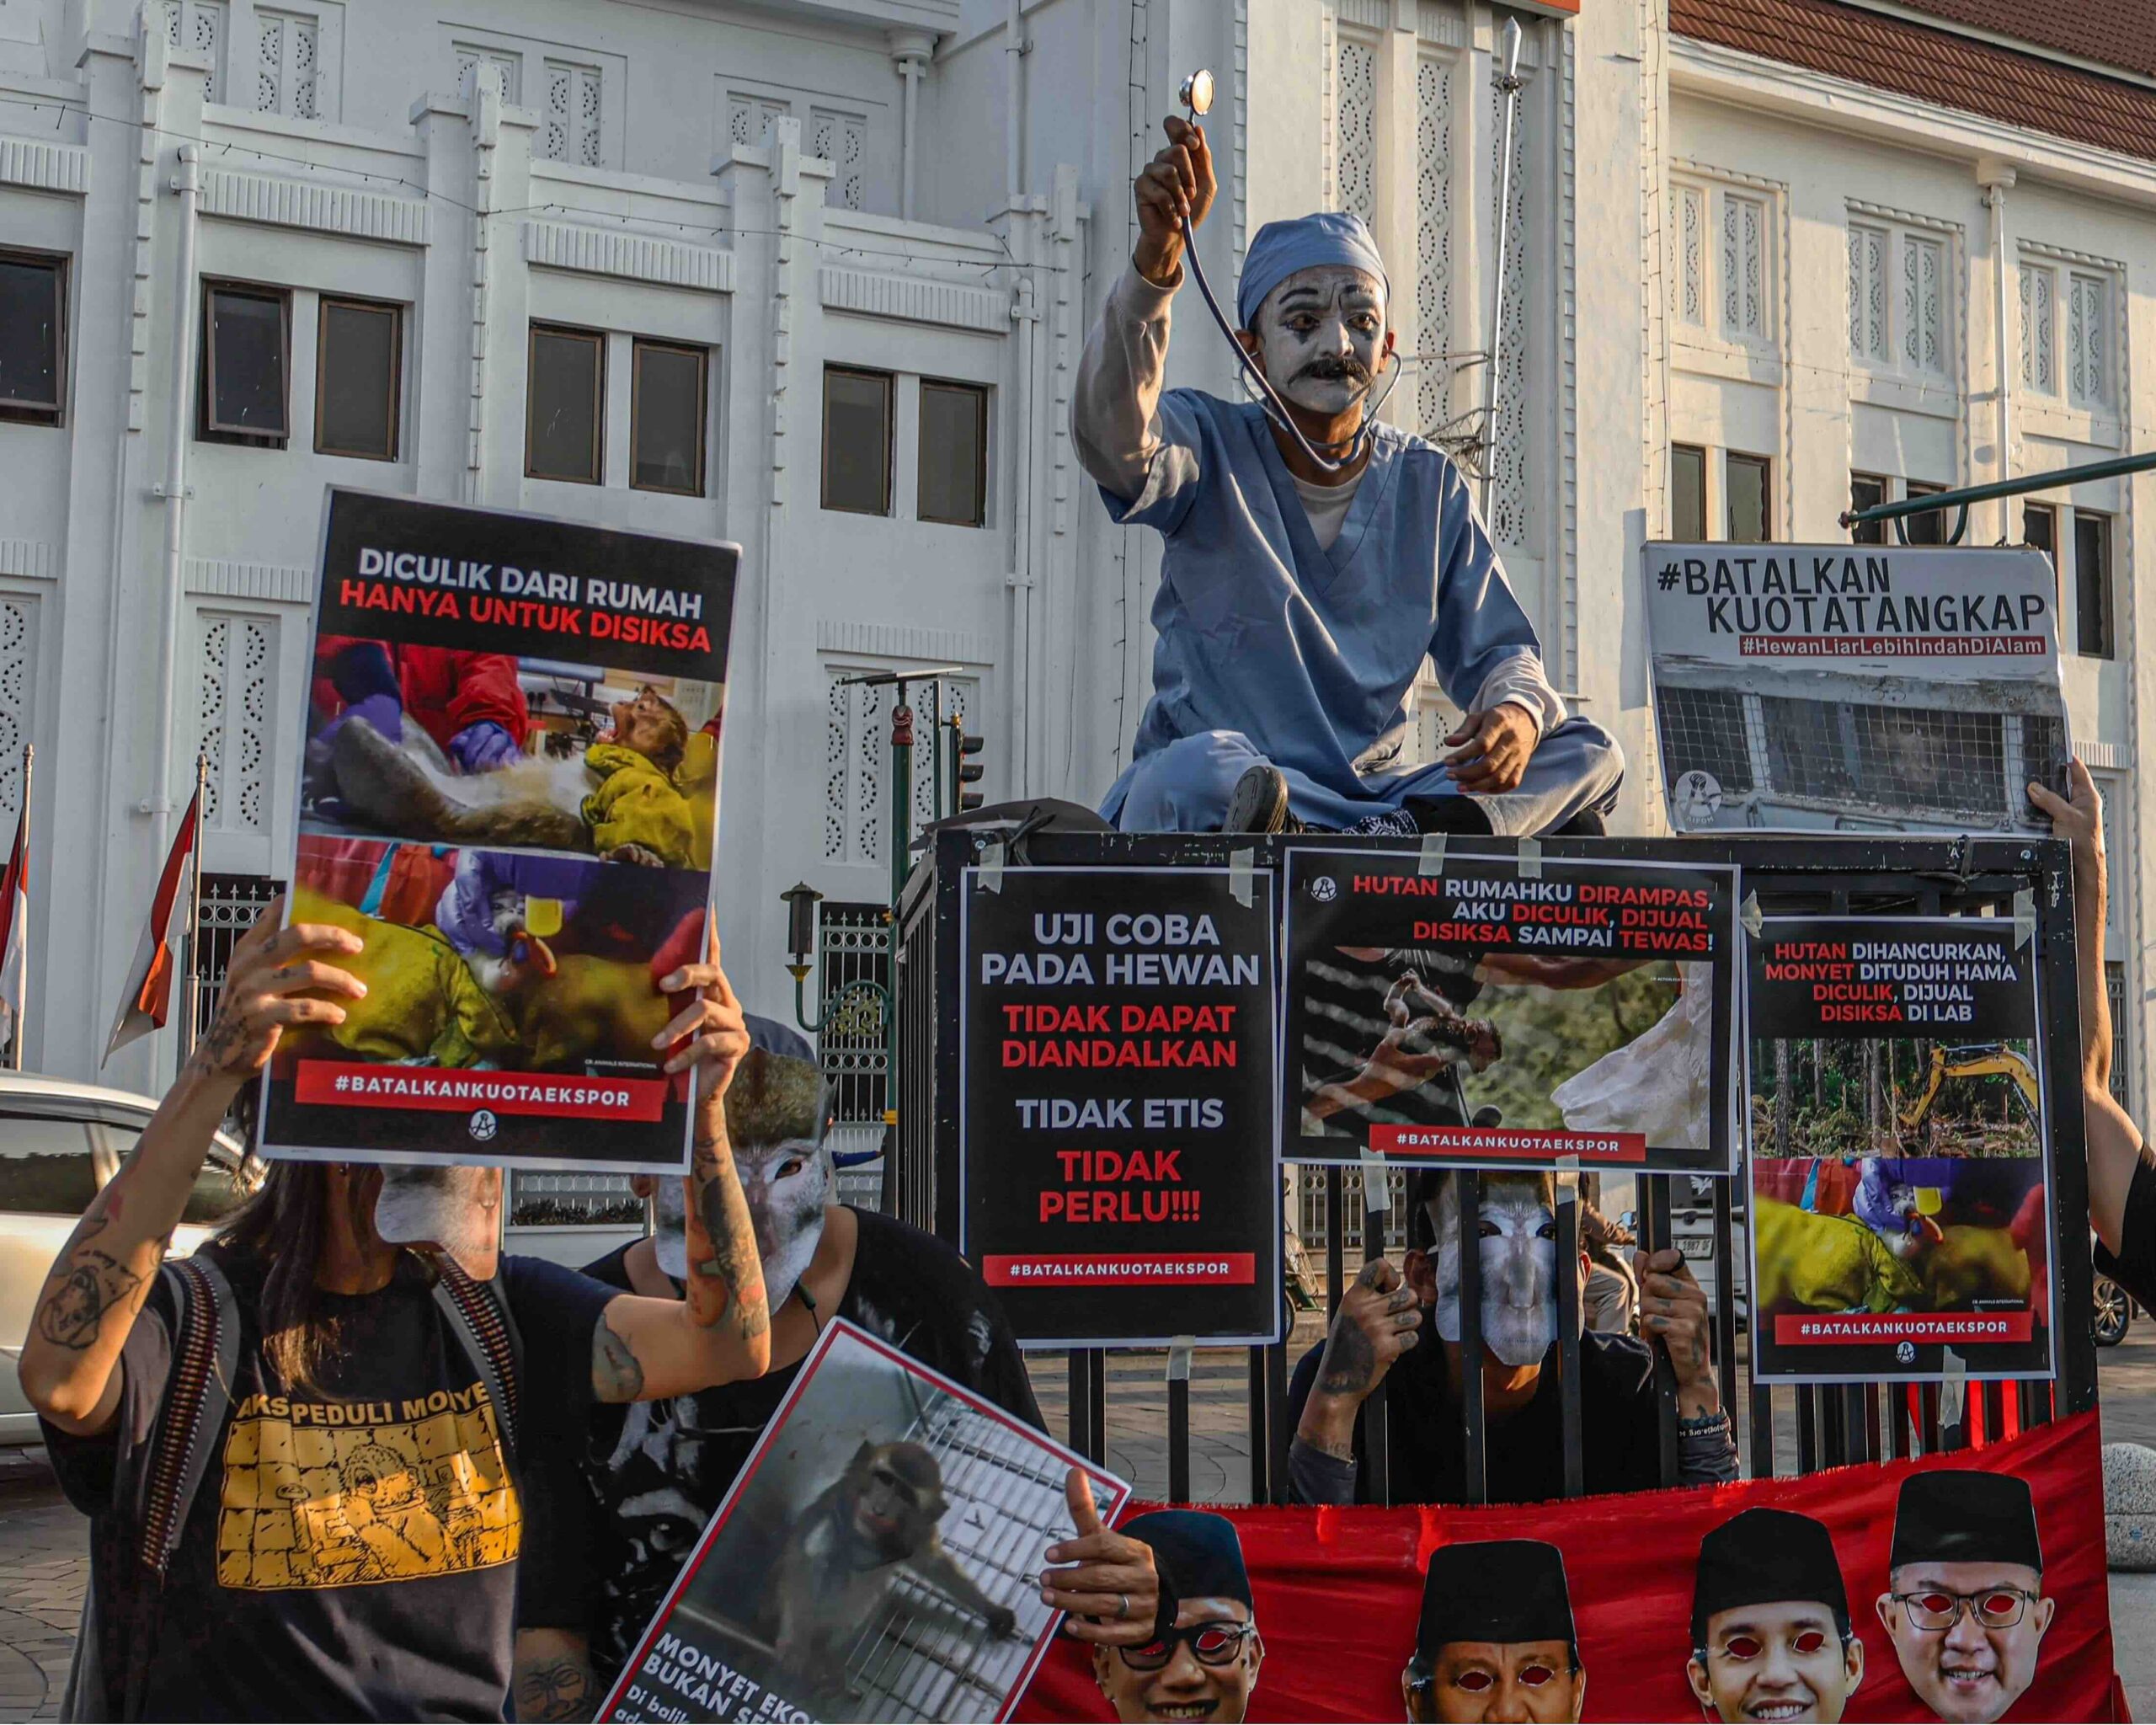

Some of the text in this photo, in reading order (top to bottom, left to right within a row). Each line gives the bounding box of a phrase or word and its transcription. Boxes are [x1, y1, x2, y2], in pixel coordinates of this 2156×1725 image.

[359, 547, 702, 619] DICULIK DARI RUMAH
[1657, 558, 1891, 595] #BATALKAN
[340, 579, 711, 652] HANYA UNTUK DISIKSA
[1707, 595, 2046, 633] KUOTATANGKAP
[1742, 638, 2041, 655] #HewanLiarLebihIndahDiAlam
[1353, 875, 1438, 896] HUTAN
[1445, 879, 1572, 901] RUMAHKU
[1579, 884, 1714, 911] DIRAMPAS,
[1034, 913, 1219, 945] UJI COBA
[1453, 901, 1708, 929] AKU DICULIK, DIJUAL
[1413, 921, 1713, 951] DISIKSA SAMPAI TEWAS!
[1775, 943, 2006, 963] HUTAN DIHANCURKAN,
[982, 953, 1259, 985] PADA HEWAN
[1765, 964, 2017, 981] MONYET DITUDUH HAMA
[1813, 984, 1973, 1003] DICULIK, DIJUAL
[1003, 1005, 1235, 1033] TIDAK DAPAT
[1821, 1005, 1972, 1022] DISIKSA DI LAB
[1002, 1040, 1236, 1067] DIANDALKAN
[335, 1076, 630, 1107] #BATALKANKUOTAEKSPOR
[1016, 1098, 1224, 1129] TIDAK ETIS
[1397, 1133, 1620, 1152] #BATALKANKUOTAEKSPOR
[1056, 1150, 1181, 1182] TIDAK
[1039, 1190, 1201, 1223] PERLU!!!
[1010, 1263, 1229, 1277] #BATALKANKUOTAEKSPOR
[1801, 1321, 2008, 1335] #BATALKANKUOTAEKSPOR
[236, 1392, 290, 1418] AKS
[291, 1402, 393, 1425] PEDULI
[643, 1656, 734, 1717] BUKAN
[655, 1632, 825, 1723] MONYET EKO
[627, 1685, 691, 1723] Di balik
